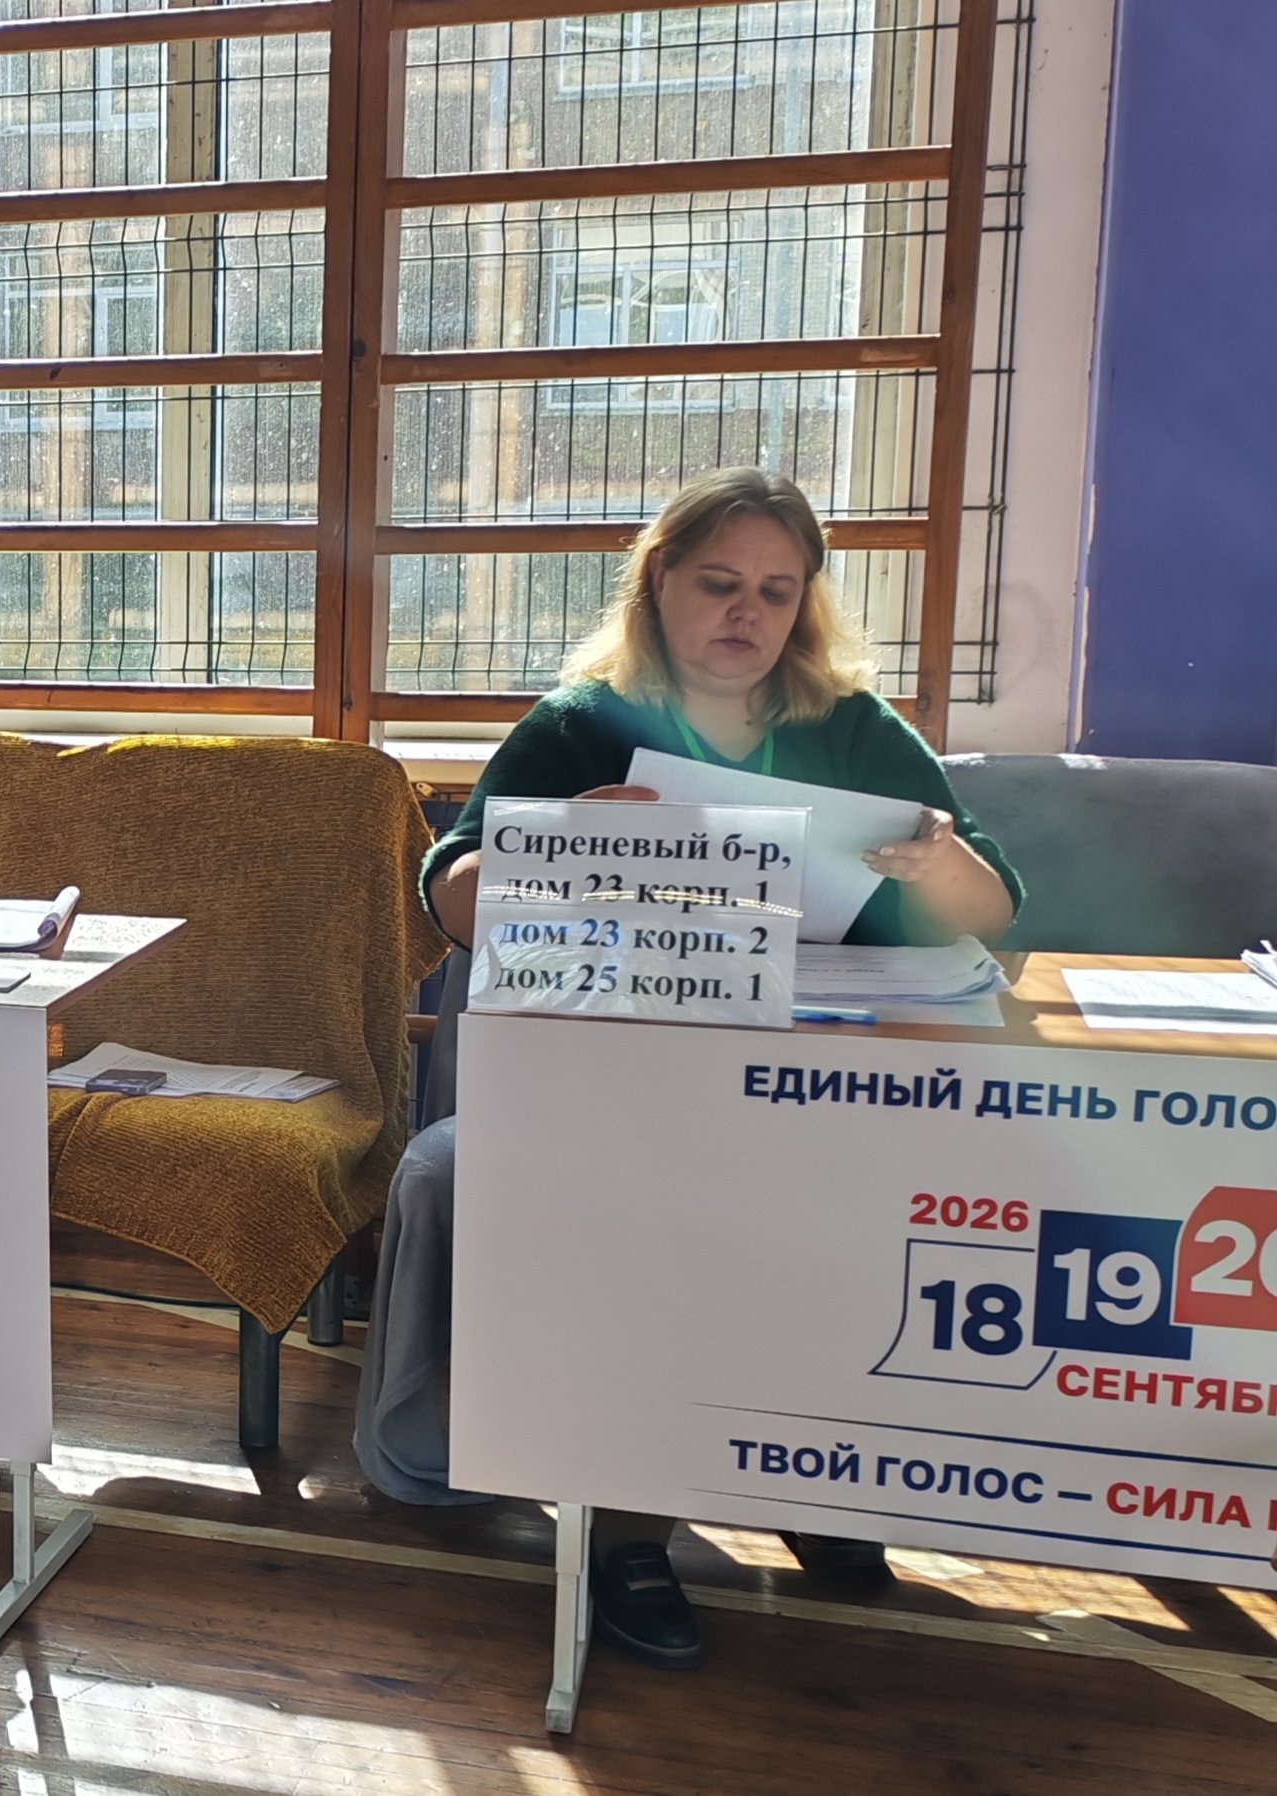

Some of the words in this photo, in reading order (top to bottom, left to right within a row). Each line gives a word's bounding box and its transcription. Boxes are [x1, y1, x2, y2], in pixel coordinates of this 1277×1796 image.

[493, 825, 710, 863] Сиреневый
[722, 833, 792, 871] б-р,
[501, 878, 572, 901] дом
[583, 874, 625, 901] 23
[636, 883, 738, 913] корп.
[755, 880, 770, 906] 1
[499, 922, 569, 946] дом
[579, 918, 620, 948] 23
[633, 926, 736, 960] корп.
[748, 926, 769, 955] 2
[494, 967, 565, 991] дом
[577, 964, 618, 993] 25
[630, 973, 732, 1005] корп.
[747, 973, 763, 1001] 1
[743, 1064, 963, 1111] ЕДИНЫЙ
[974, 1079, 1118, 1120] ДЕНЬ
[908, 1192, 1030, 1233] 2026
[920, 1279, 1024, 1356] 18
[1052, 1247, 1162, 1326] 19
[728, 1438, 861, 1484] ТВОЙ
[875, 1456, 1045, 1504] ГОЛОС
[1106, 1481, 1252, 1529] СИЛА
